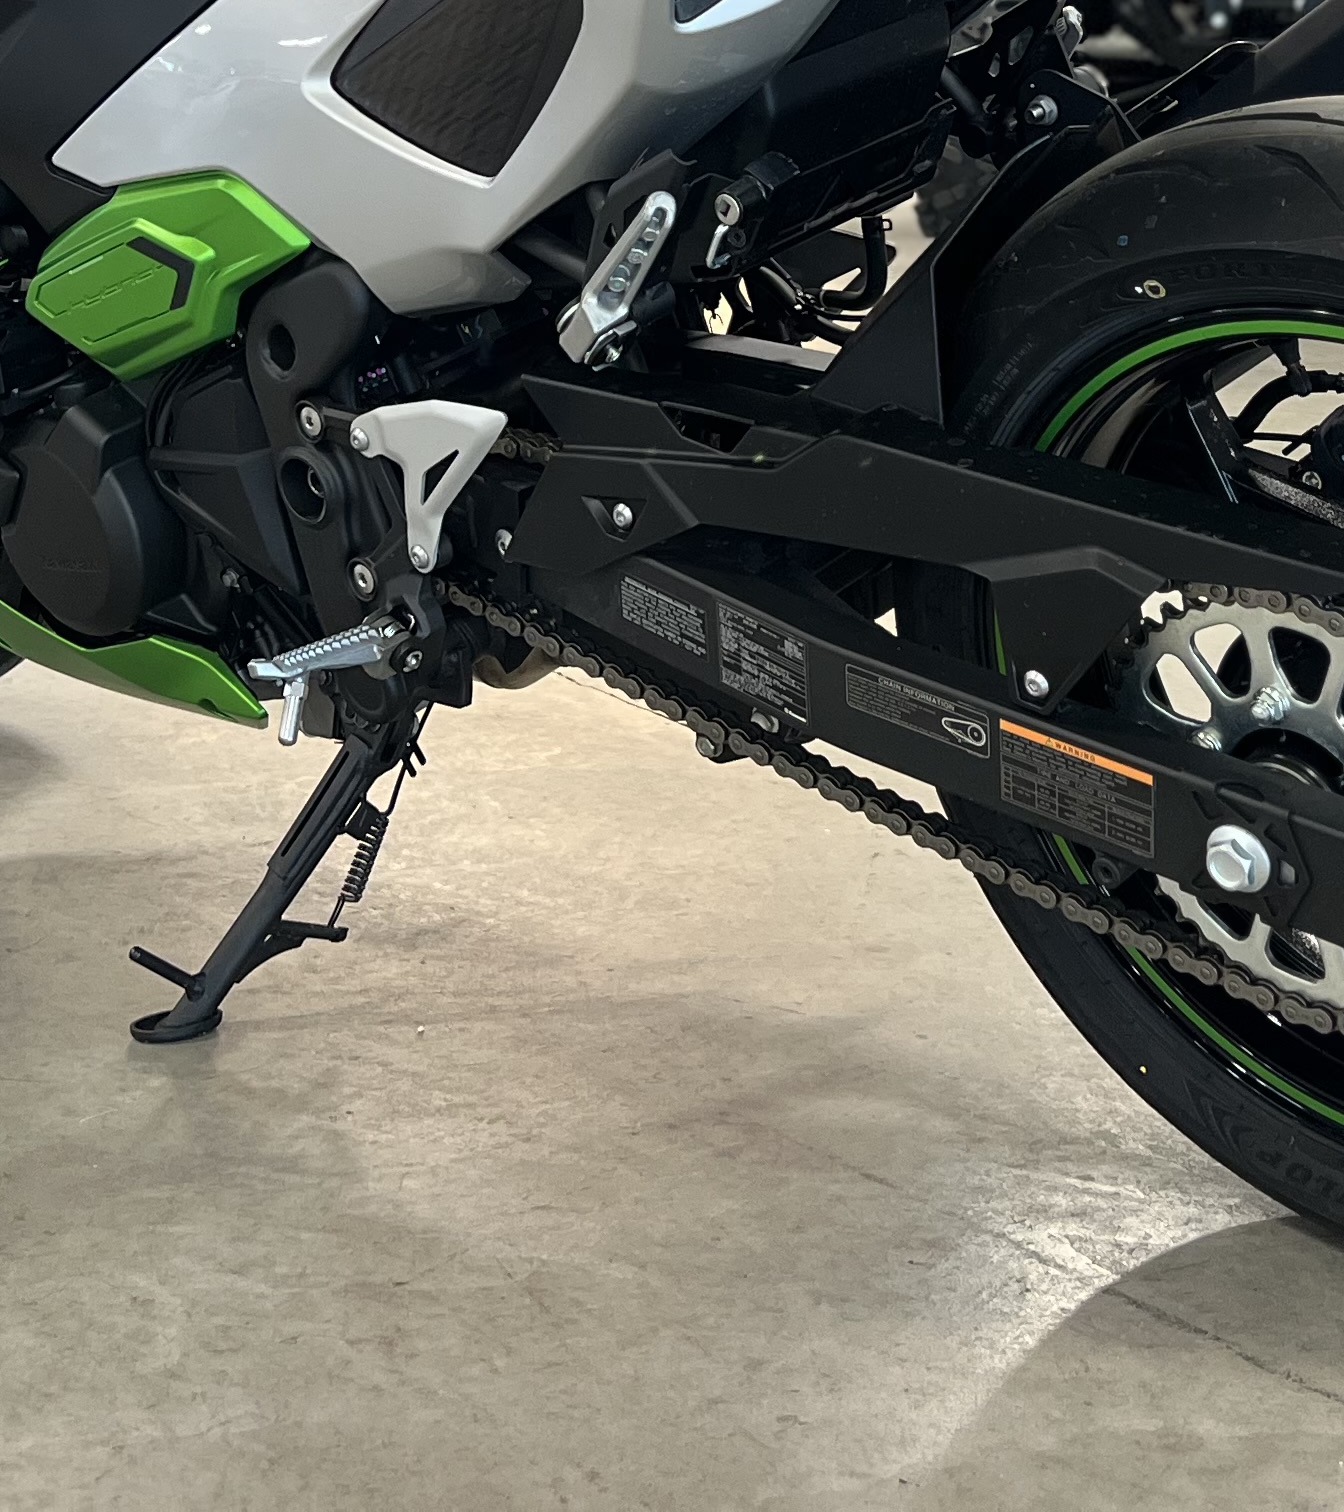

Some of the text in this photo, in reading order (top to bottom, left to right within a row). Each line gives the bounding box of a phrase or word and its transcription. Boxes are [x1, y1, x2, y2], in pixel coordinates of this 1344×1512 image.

[877, 676, 956, 712] CHAIN INFORMATION
[1054, 741, 1097, 764] WARNING
